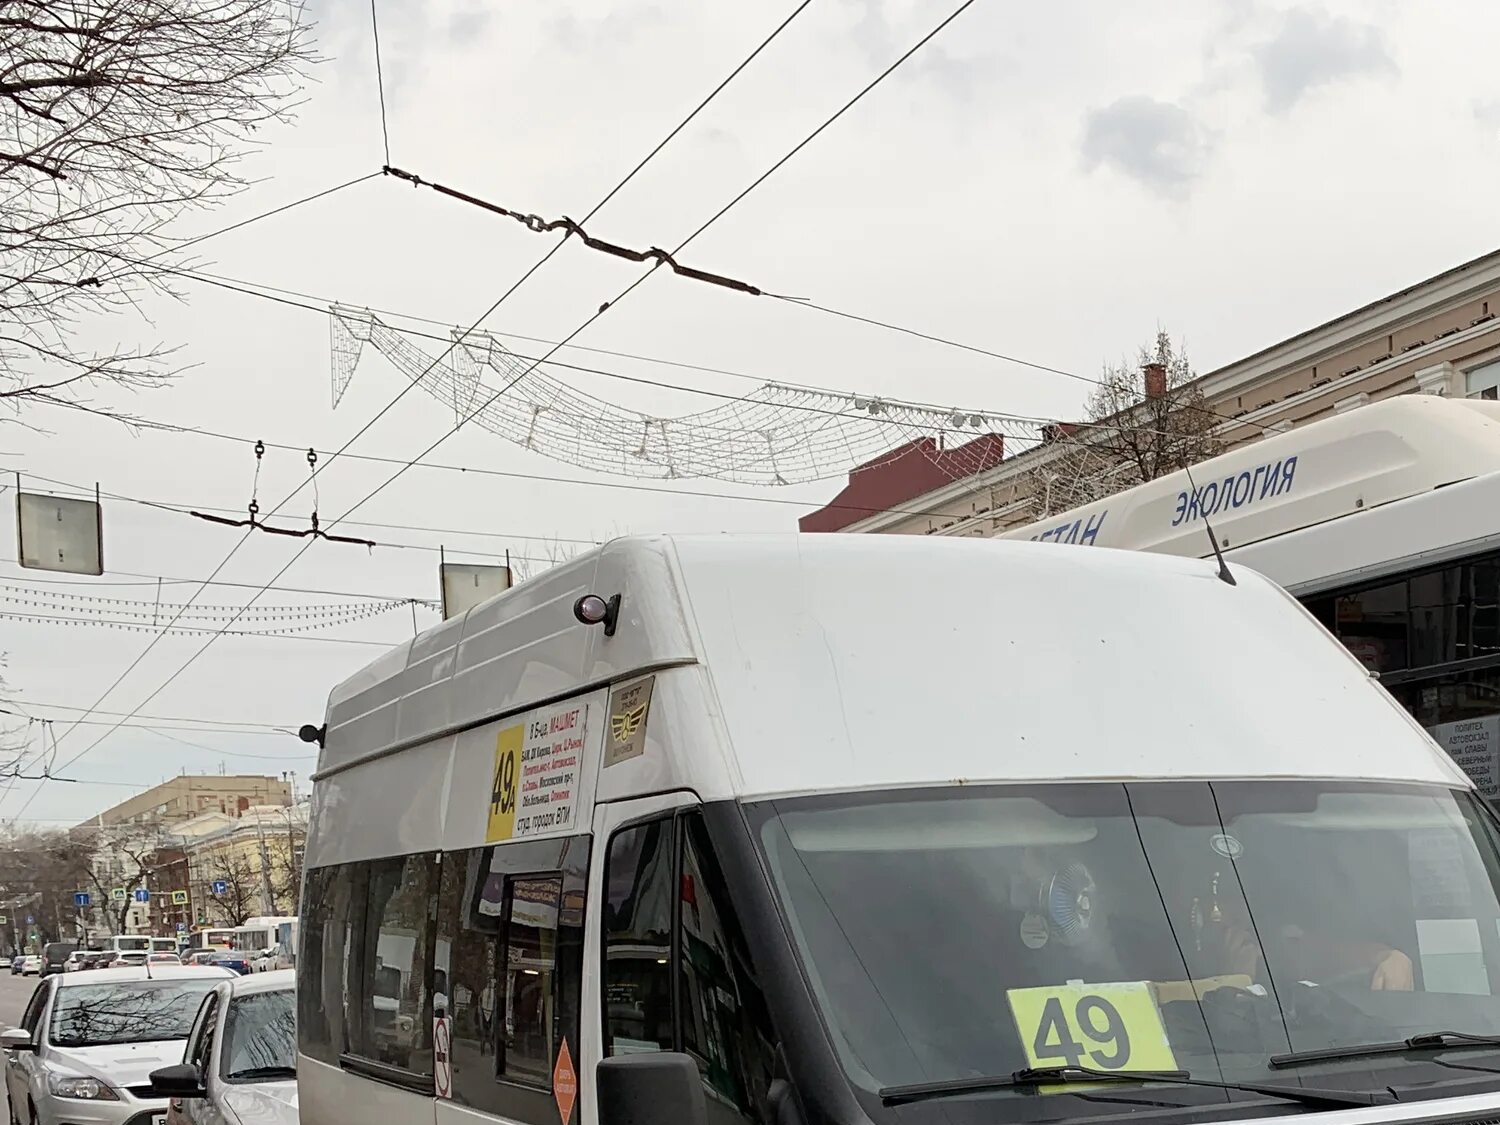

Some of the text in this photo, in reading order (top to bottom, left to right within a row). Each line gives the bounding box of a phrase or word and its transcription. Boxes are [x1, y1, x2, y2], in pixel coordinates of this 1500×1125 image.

[1172, 456, 1298, 527] ЭКОЛОГИЯ
[550, 709, 580, 734] МАШМЕТ
[1454, 721, 1484, 733] ПОЛИТЕХ
[1448, 731, 1490, 745] АВТОВОКЗАЛ
[1464, 742, 1488, 754] СЛАВЫ
[532, 812, 555, 832] городок
[555, 805, 571, 825] ВПИ
[1033, 995, 1131, 1069] 49
